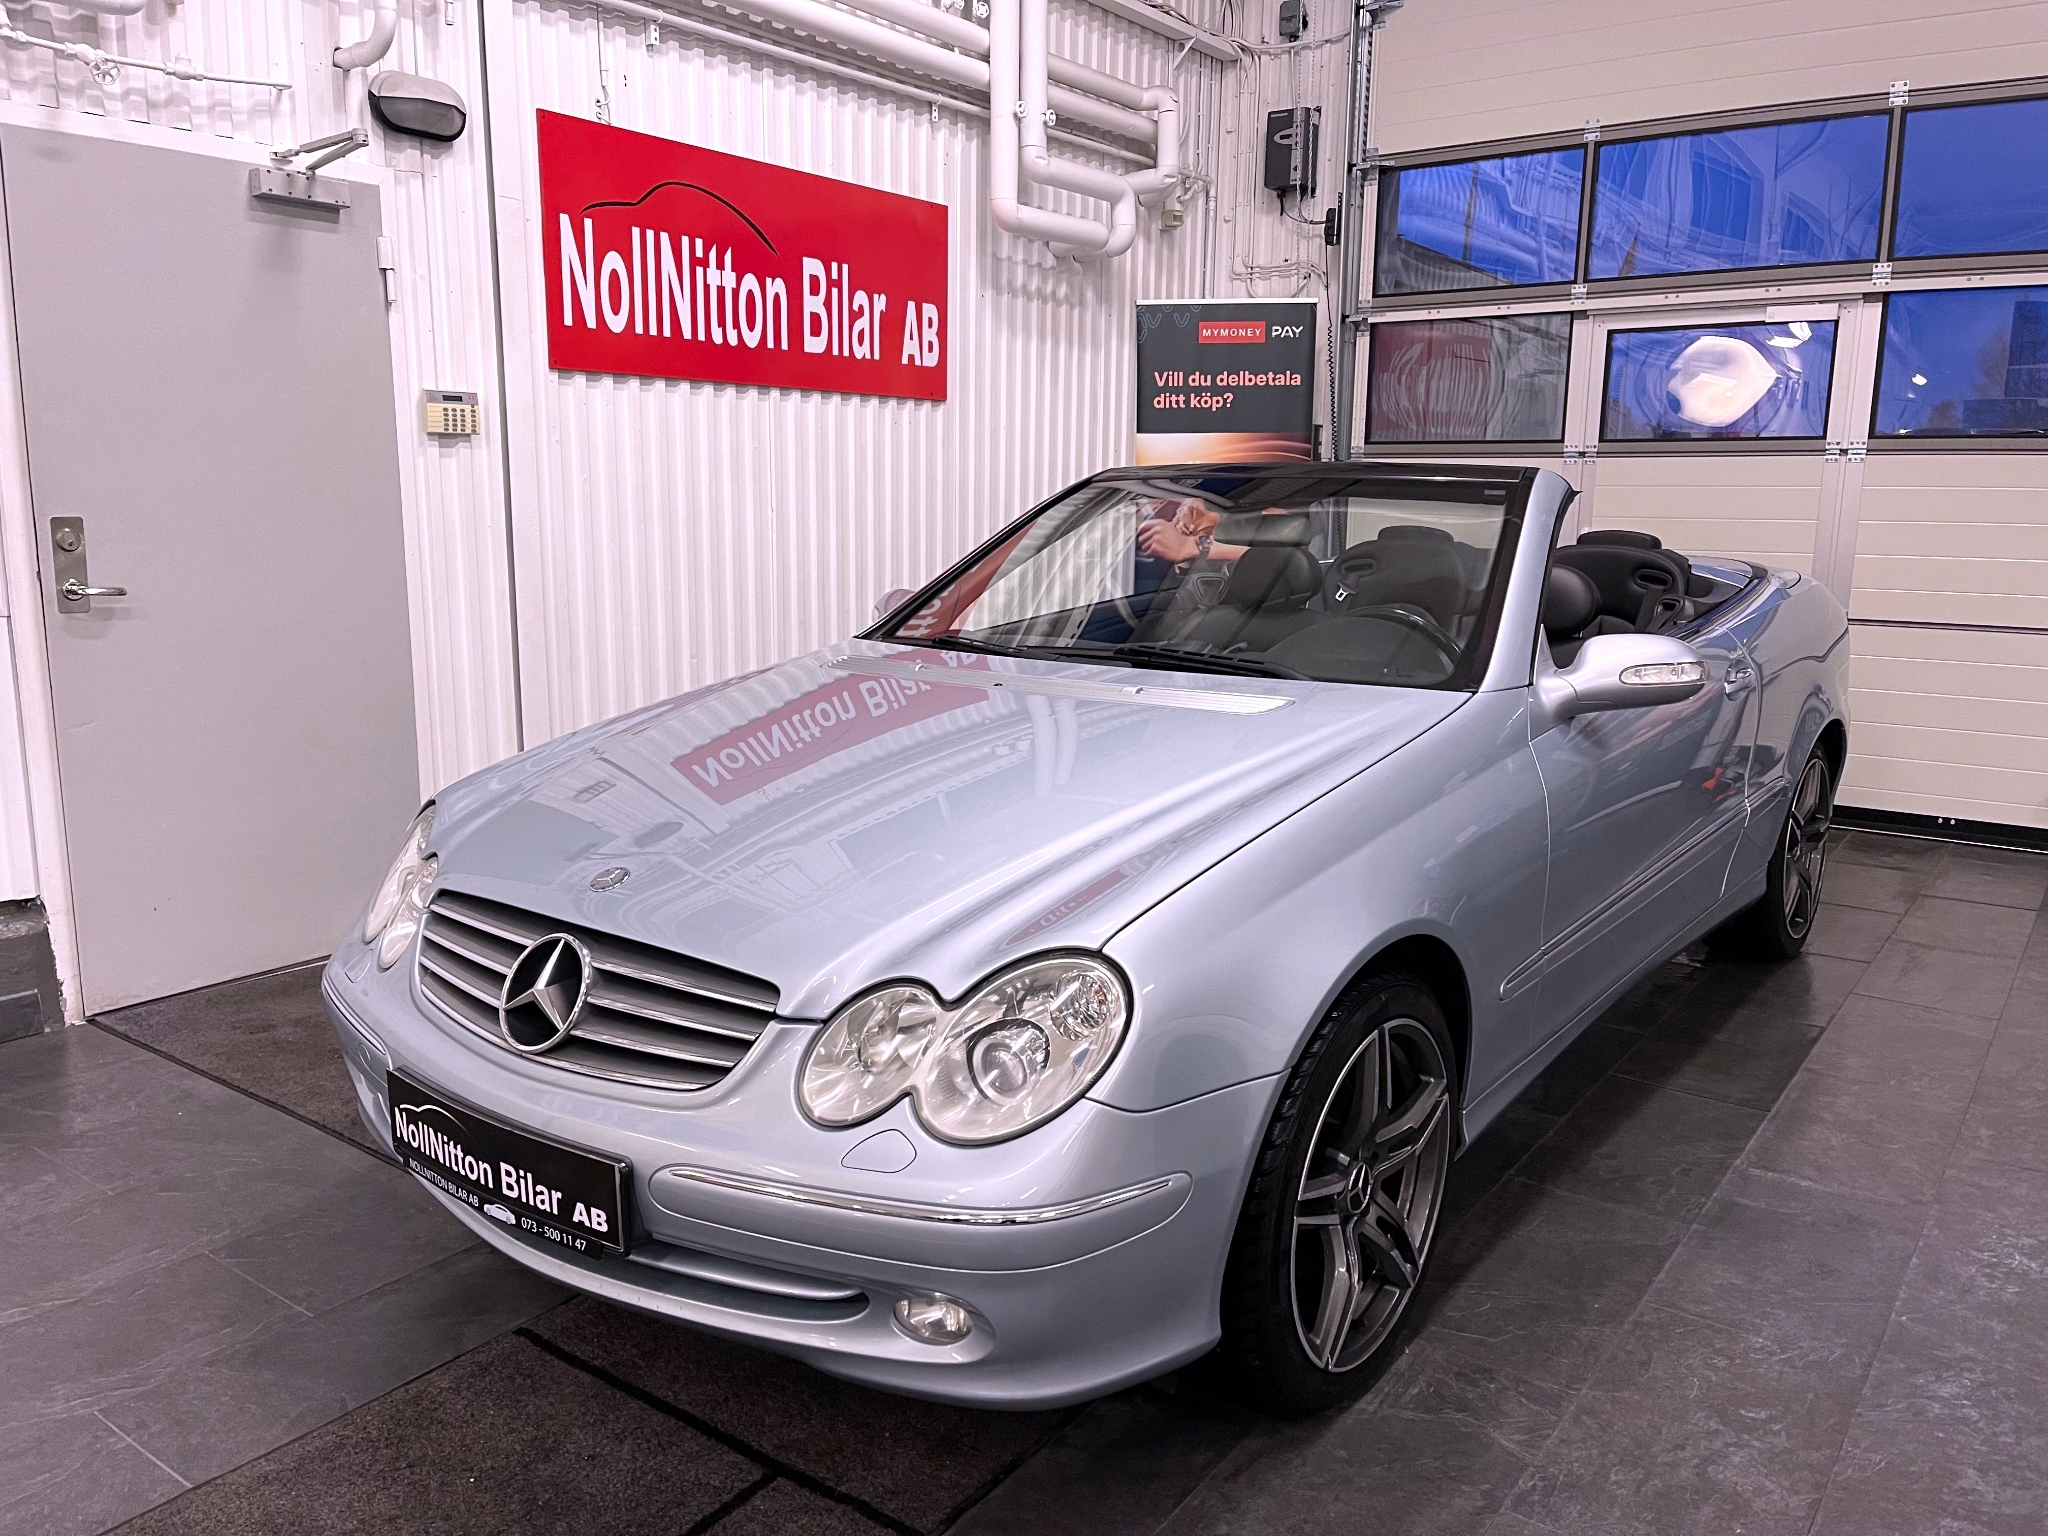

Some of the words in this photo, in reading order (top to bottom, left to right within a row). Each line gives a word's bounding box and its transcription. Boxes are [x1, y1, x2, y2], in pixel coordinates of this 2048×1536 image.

[559, 212, 789, 351] NollNitton
[802, 256, 887, 361] Bilar
[902, 300, 940, 367] AB
[1202, 328, 1262, 337] MYMONEY
[1271, 325, 1304, 338] PAY
[1154, 372, 1184, 387] Vill
[1188, 372, 1212, 387] du
[1216, 371, 1302, 387] delbetala
[1153, 393, 1186, 409] ditt
[1190, 392, 1234, 411] köp?
[394, 1106, 494, 1189] NollNitton
[499, 1161, 562, 1215] Bilar
[572, 1202, 609, 1233] AB
[409, 1157, 448, 1191] NOLLNITTON
[448, 1182, 468, 1203] BILAR
[468, 1193, 479, 1207] AB
[521, 1217, 537, 1233] 073
[544, 1226, 561, 1241] 500
[562, 1233, 572, 1246] 11
[575, 1238, 587, 1251] 47
